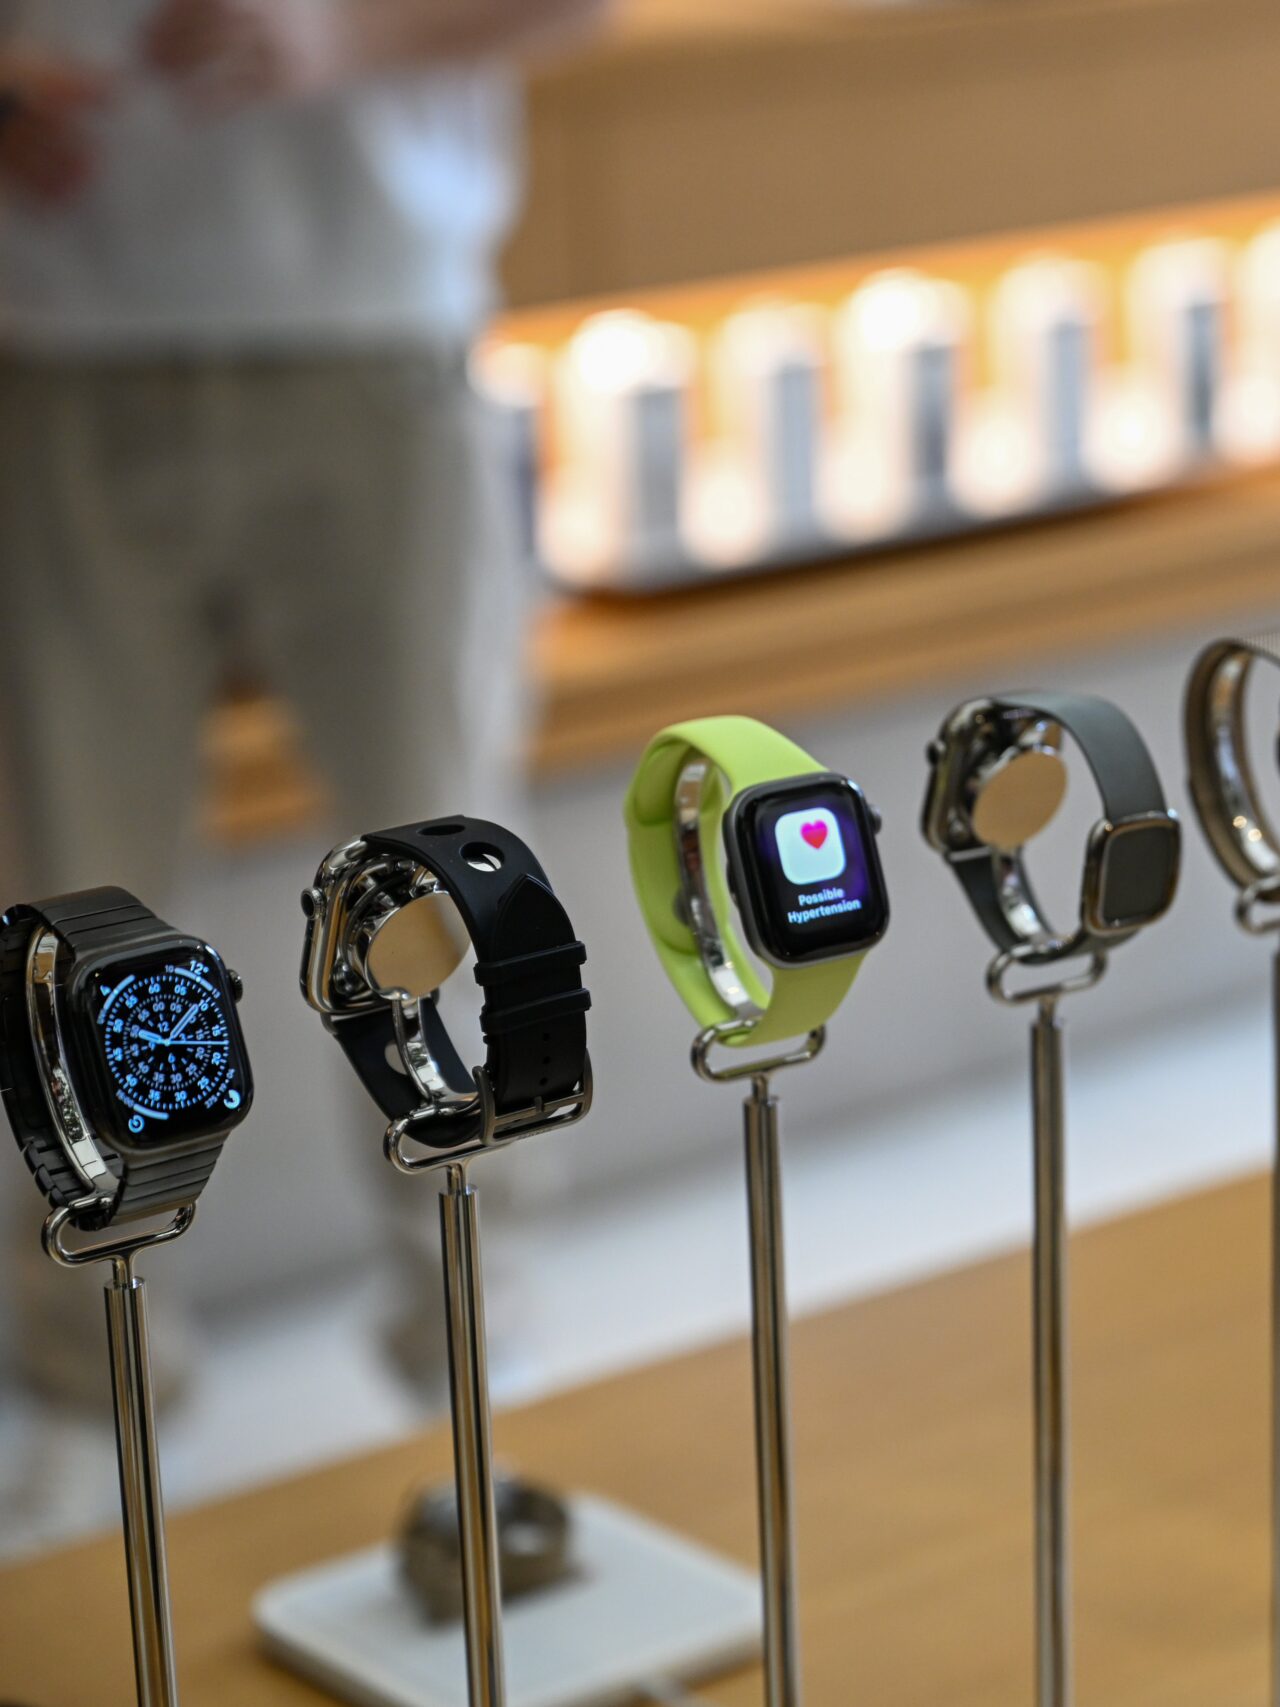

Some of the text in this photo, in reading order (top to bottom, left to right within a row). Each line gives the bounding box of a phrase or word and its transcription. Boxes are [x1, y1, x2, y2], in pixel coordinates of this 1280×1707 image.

[798, 887, 845, 906] Possible
[787, 899, 862, 924] Hypertension
[174, 984, 187, 996] 05
[157, 1021, 170, 1033] 12
[168, 1052, 176, 1064] 6
[211, 1052, 222, 1066] 20
